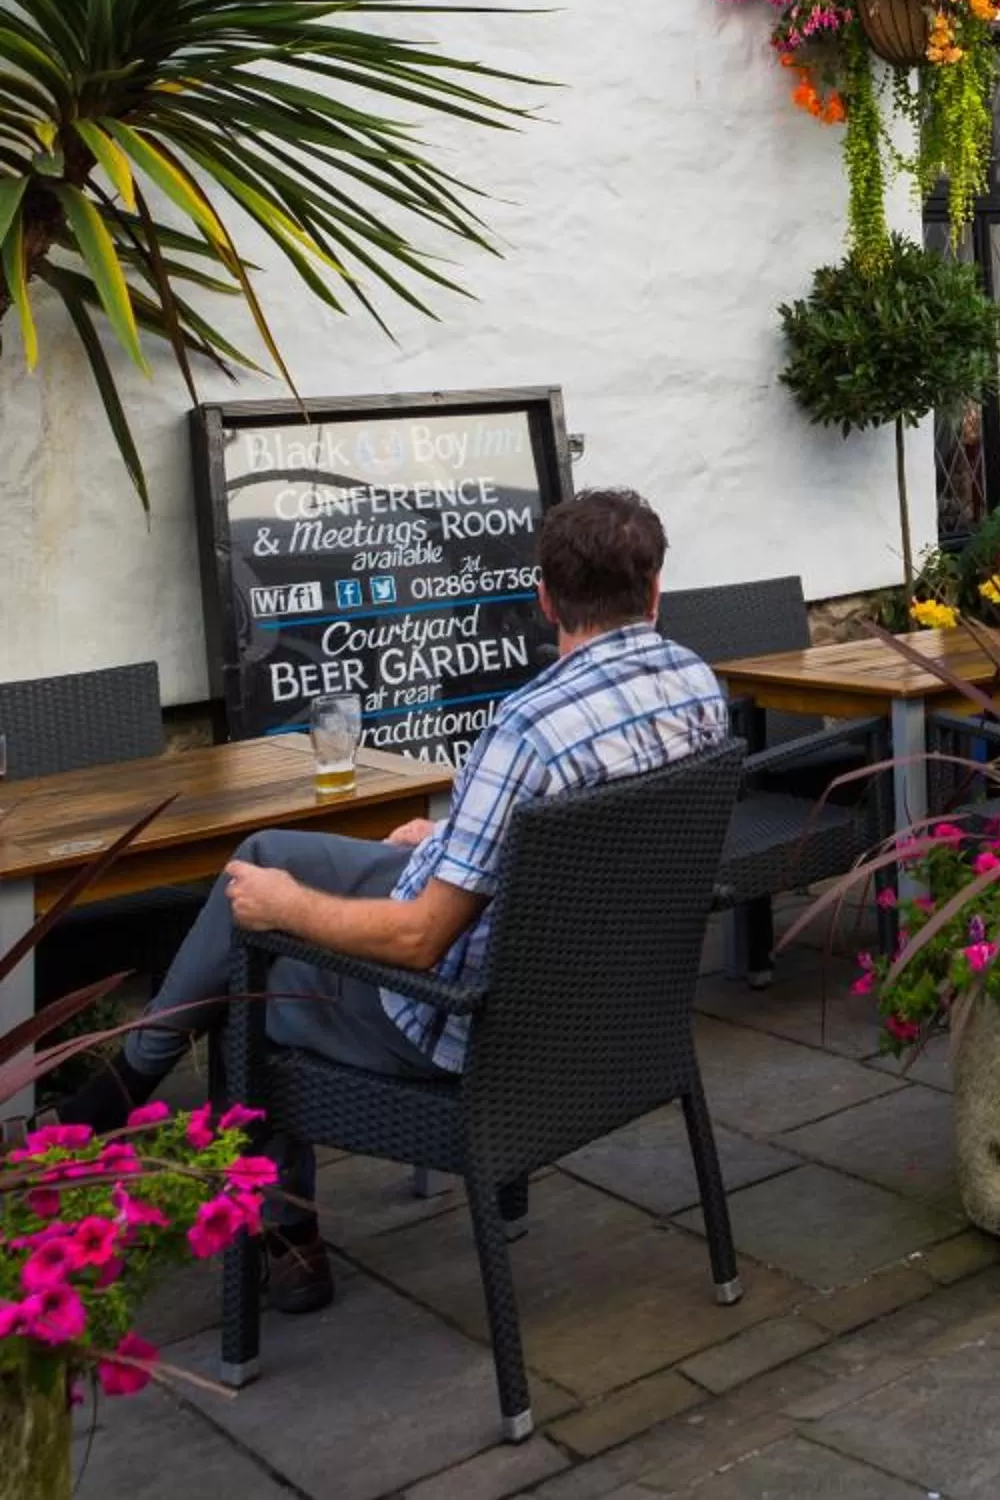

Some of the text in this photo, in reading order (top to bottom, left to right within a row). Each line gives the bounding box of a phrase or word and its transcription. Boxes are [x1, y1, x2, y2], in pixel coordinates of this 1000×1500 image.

[246, 421, 523, 471] Black Boy Inn
[274, 476, 499, 521] CONFERENCE
[253, 506, 535, 557] & Meetings ROOM
[352, 542, 444, 572] available
[321, 603, 480, 656] Courtyard
[269, 634, 530, 702] BEER GARDEN
[365, 682, 443, 712] at rear
[361, 699, 495, 747] raditional
